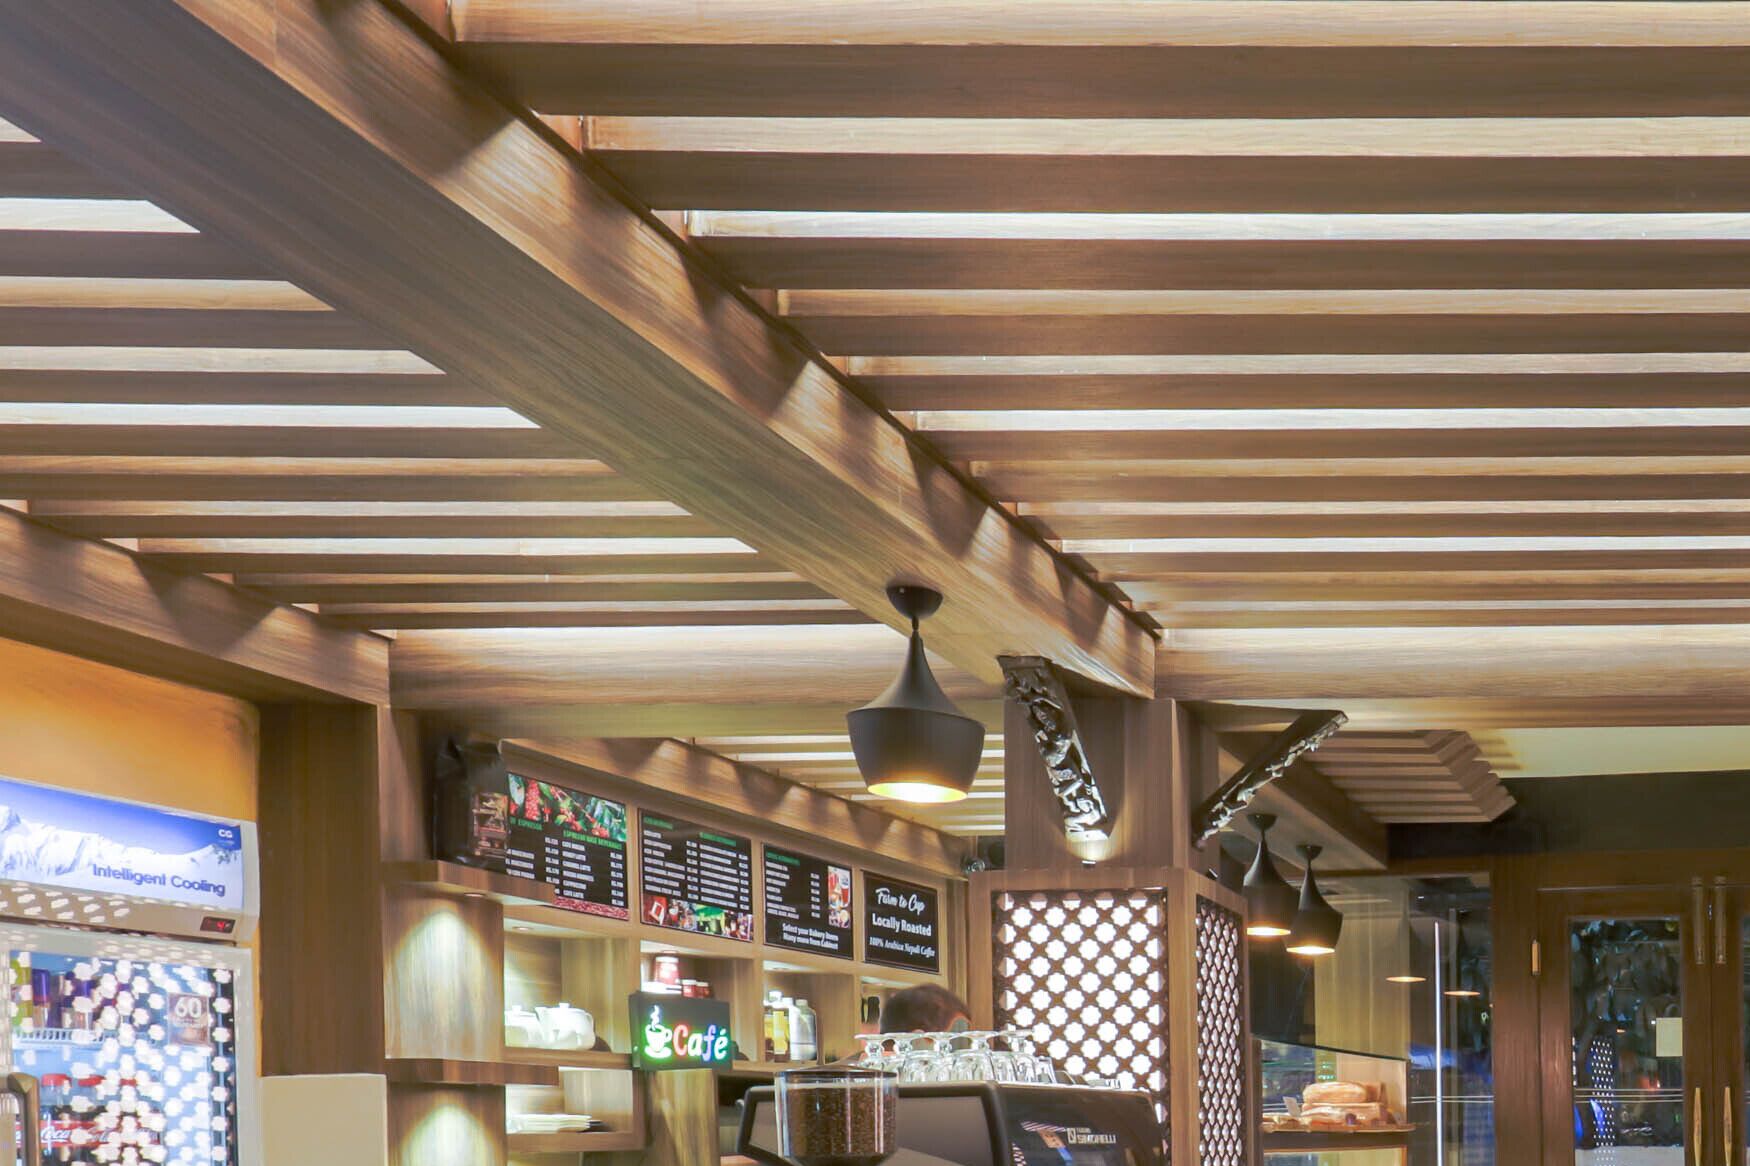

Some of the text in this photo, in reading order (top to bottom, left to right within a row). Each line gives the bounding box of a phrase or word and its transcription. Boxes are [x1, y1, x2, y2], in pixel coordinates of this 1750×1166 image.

[92, 863, 226, 897] Intelligent Cooling
[898, 895, 908, 908] to
[908, 894, 926, 915] Cup
[872, 912, 932, 937] Locally Roasted
[175, 997, 202, 1019] 60
[673, 1024, 728, 1061] Café
